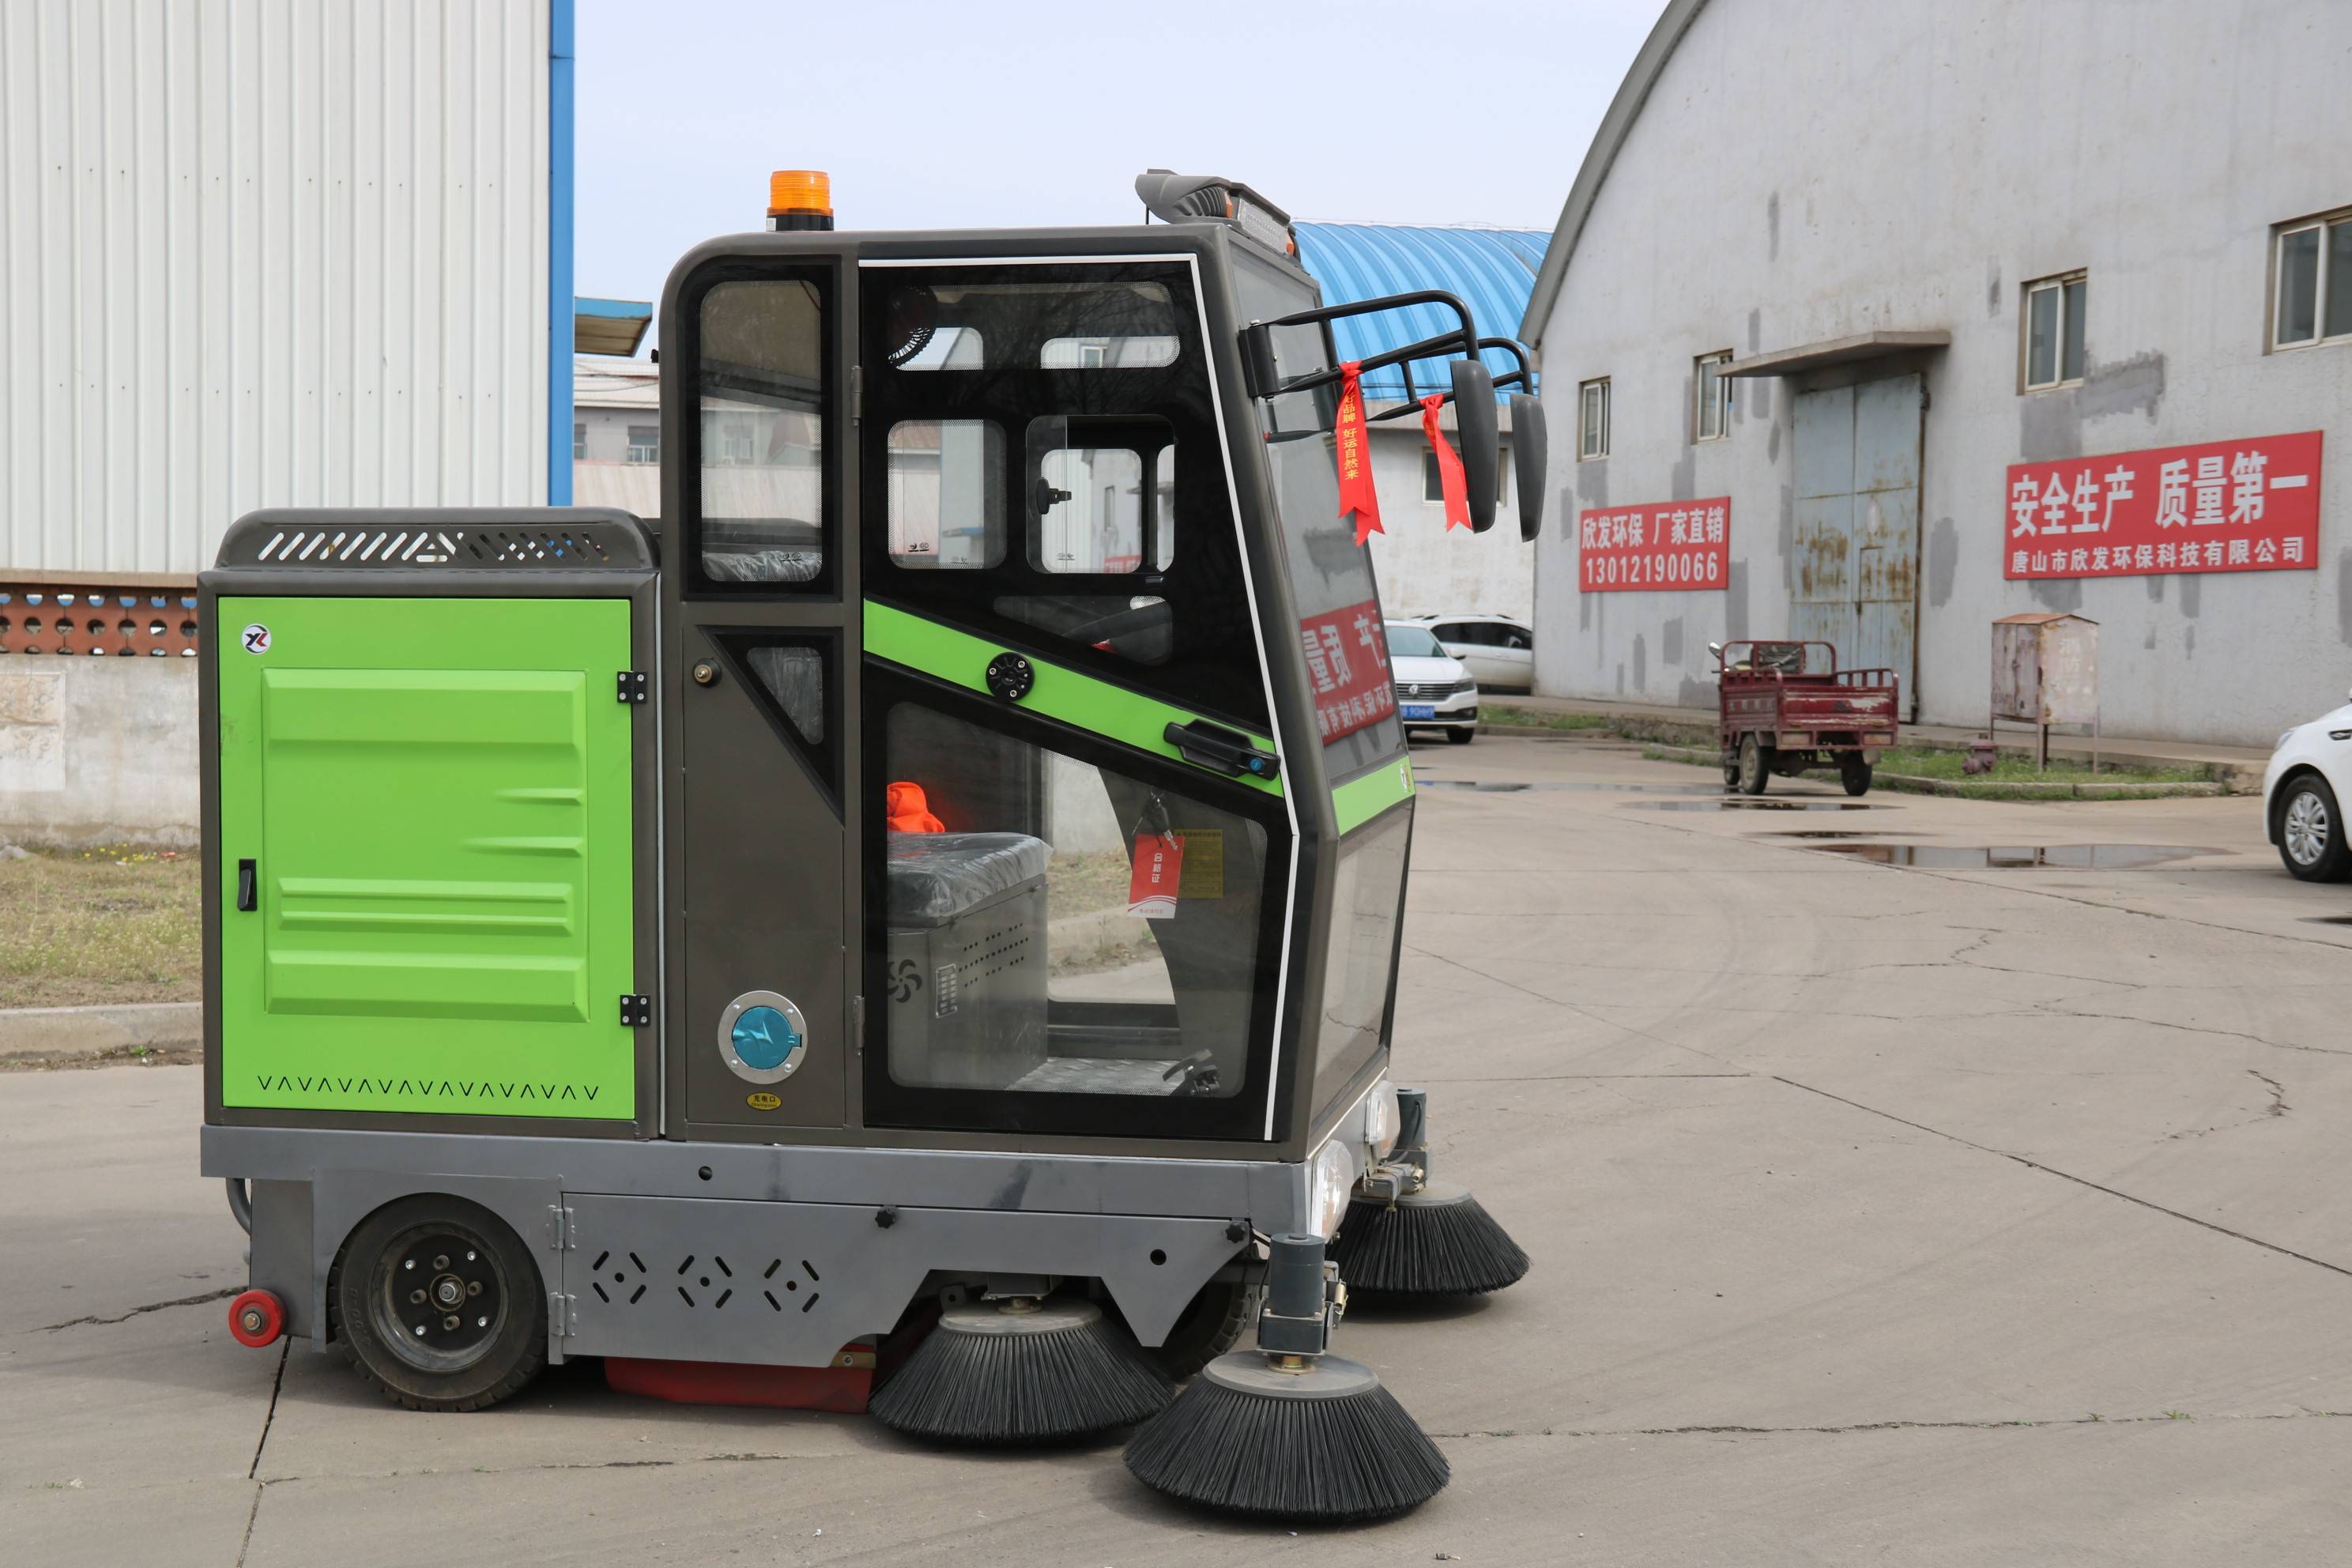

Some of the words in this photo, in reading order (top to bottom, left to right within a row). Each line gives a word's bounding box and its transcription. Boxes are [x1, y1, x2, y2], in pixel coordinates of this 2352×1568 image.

[1342, 428, 1359, 481] 好运自然来
[2011, 465, 2135, 538] 安全生产
[2154, 450, 2309, 529] 质量第一
[1581, 513, 1644, 550] 欣发环保
[1653, 506, 1724, 545] 厂家直销
[1586, 552, 1717, 583] 13012190066
[2011, 537, 2305, 574] 唐山市欣发环保科技有限公司
